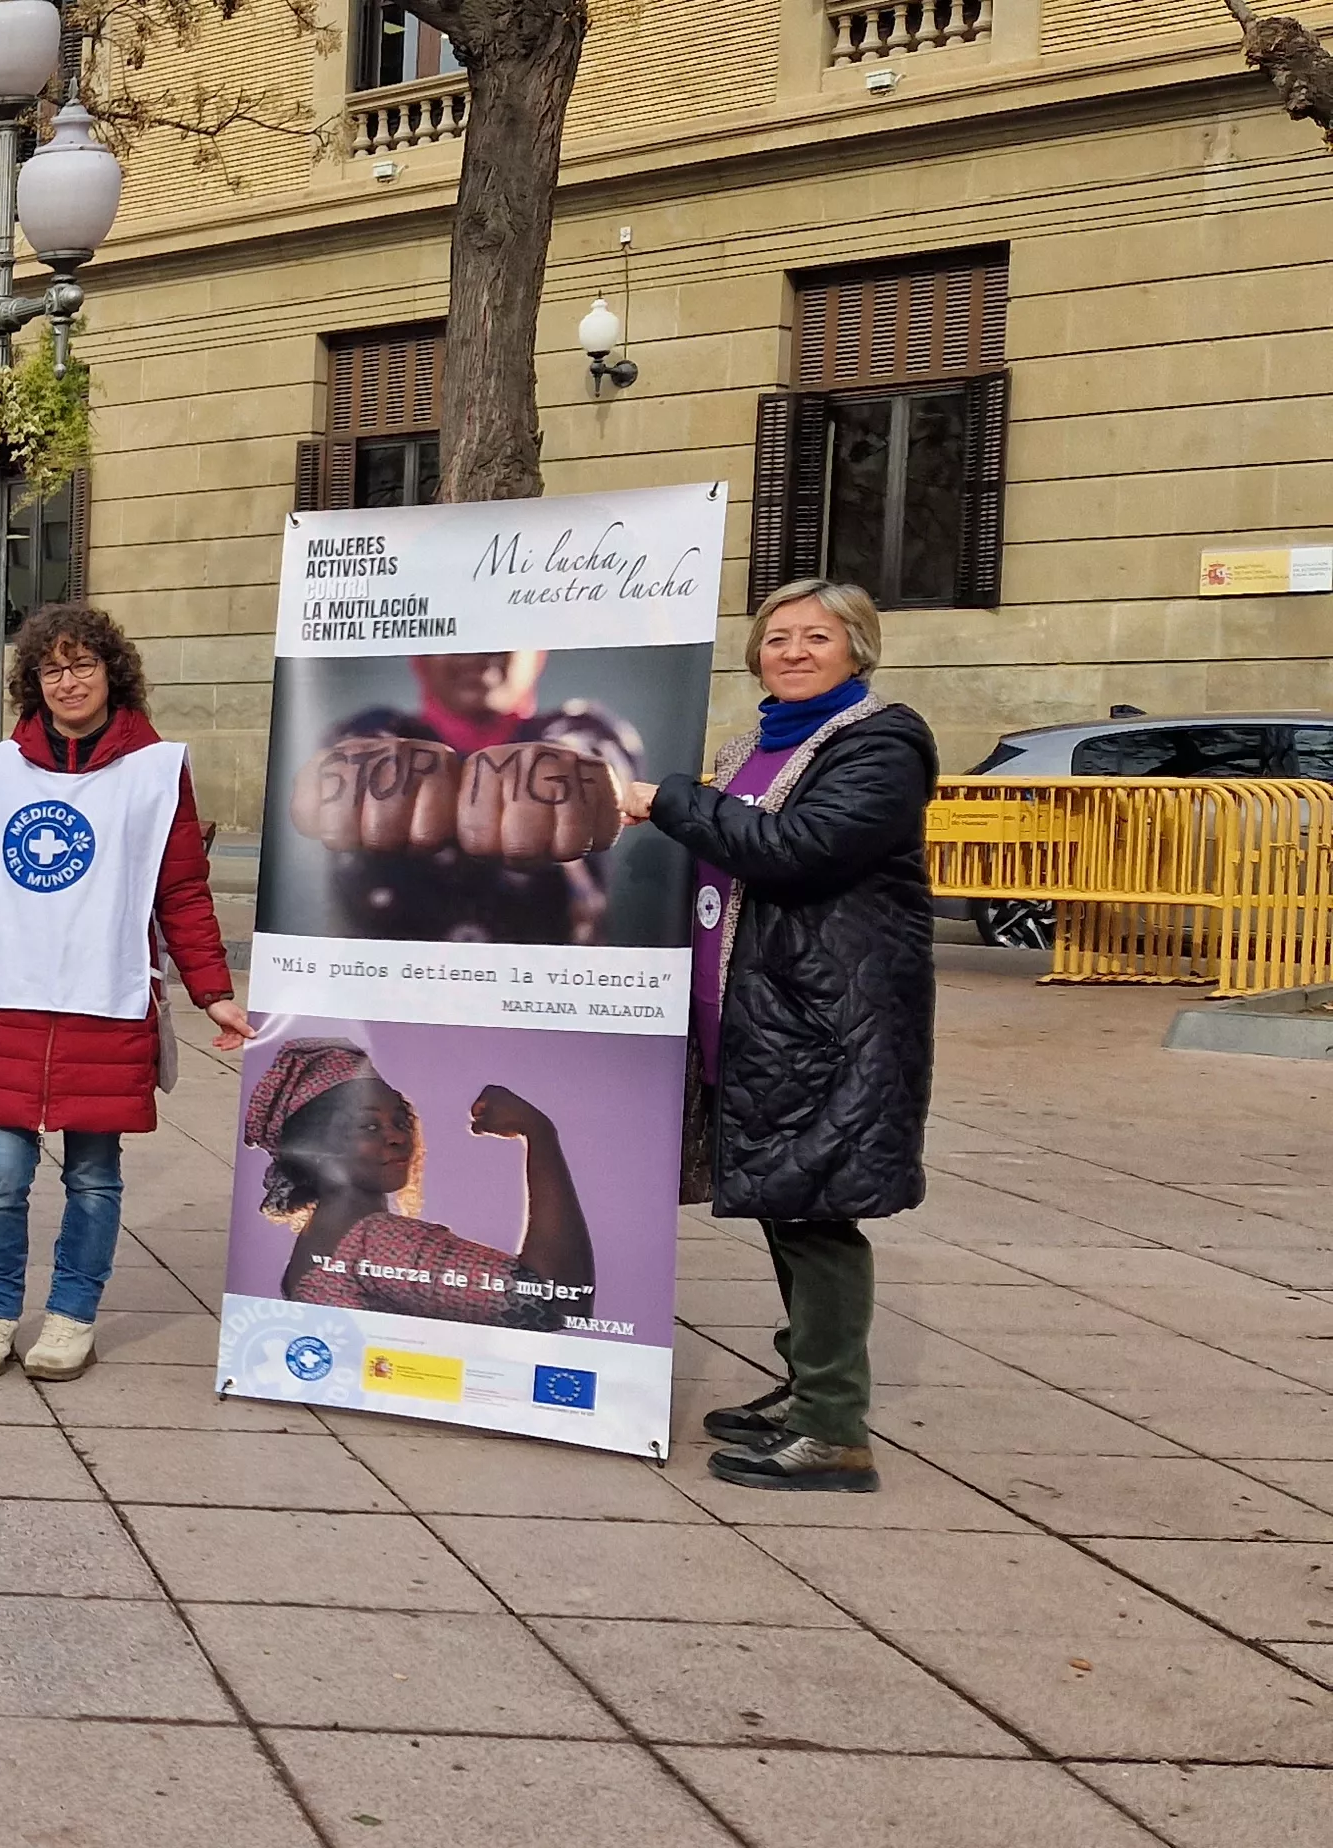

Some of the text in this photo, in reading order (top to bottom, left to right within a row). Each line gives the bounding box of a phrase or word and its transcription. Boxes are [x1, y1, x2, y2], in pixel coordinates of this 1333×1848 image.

[307, 536, 386, 558] MUJERES
[474, 521, 628, 582] Mi lucha,
[305, 556, 399, 578] ACTIVISTAS
[508, 547, 701, 606] nuestra lucha
[306, 577, 370, 600] CONTRA
[303, 593, 429, 620] LA MUTILACIÓN
[302, 618, 457, 641] GENITAL FEMENINA
[318, 747, 601, 807] STOP MGF
[6, 806, 84, 888] MÉDICOS DEL MUNDO
[329, 962, 387, 977] puños
[401, 964, 496, 981] detienen
[511, 968, 533, 984] la
[502, 1000, 664, 1017] MARIANA NALAUDA
[358, 1260, 431, 1283] fuerza
[442, 1269, 468, 1288] de
[480, 1273, 505, 1293] la
[565, 1315, 635, 1336] MARYAM
